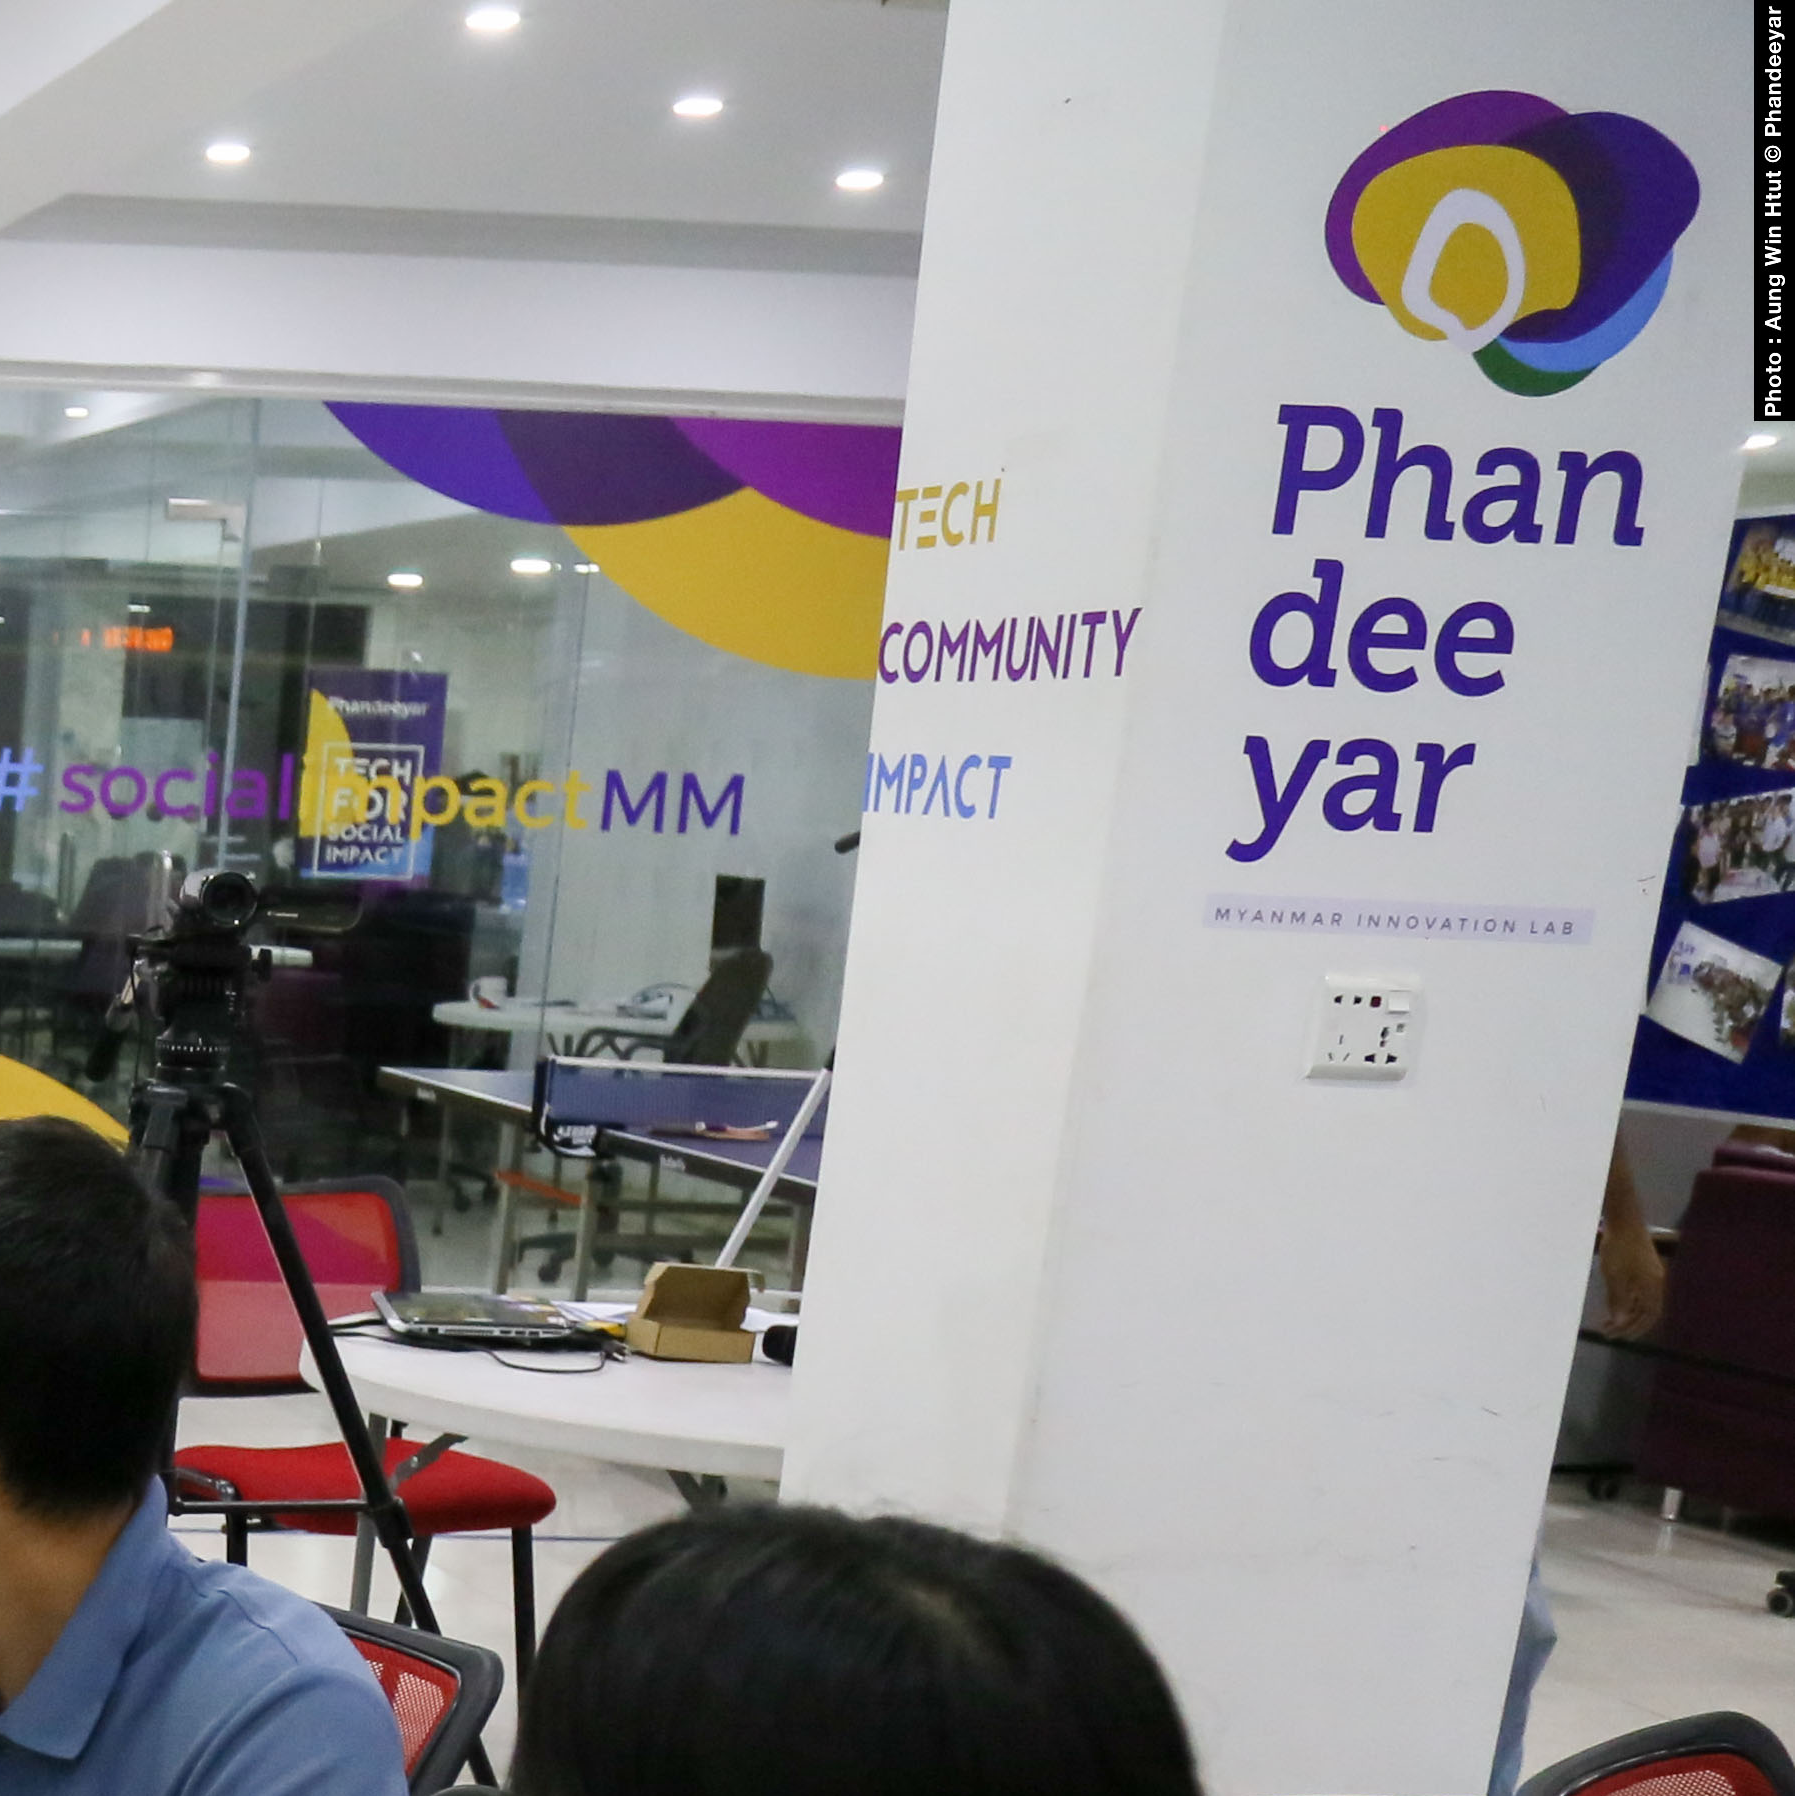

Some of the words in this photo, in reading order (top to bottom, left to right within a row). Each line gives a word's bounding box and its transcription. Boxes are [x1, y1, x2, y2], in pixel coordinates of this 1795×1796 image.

[1271, 403, 1645, 547] Phan
[895, 478, 1002, 551] TECH
[877, 607, 1144, 684] COMMUNITY
[1248, 558, 1515, 698] dee
[861, 752, 1013, 820] IMPACT
[1224, 735, 1477, 863] yar
[323, 842, 405, 867] IMPACT
[1213, 907, 1344, 928] MYANMAR
[1356, 913, 1516, 934] INNOVATION
[1528, 920, 1576, 936] LAB
